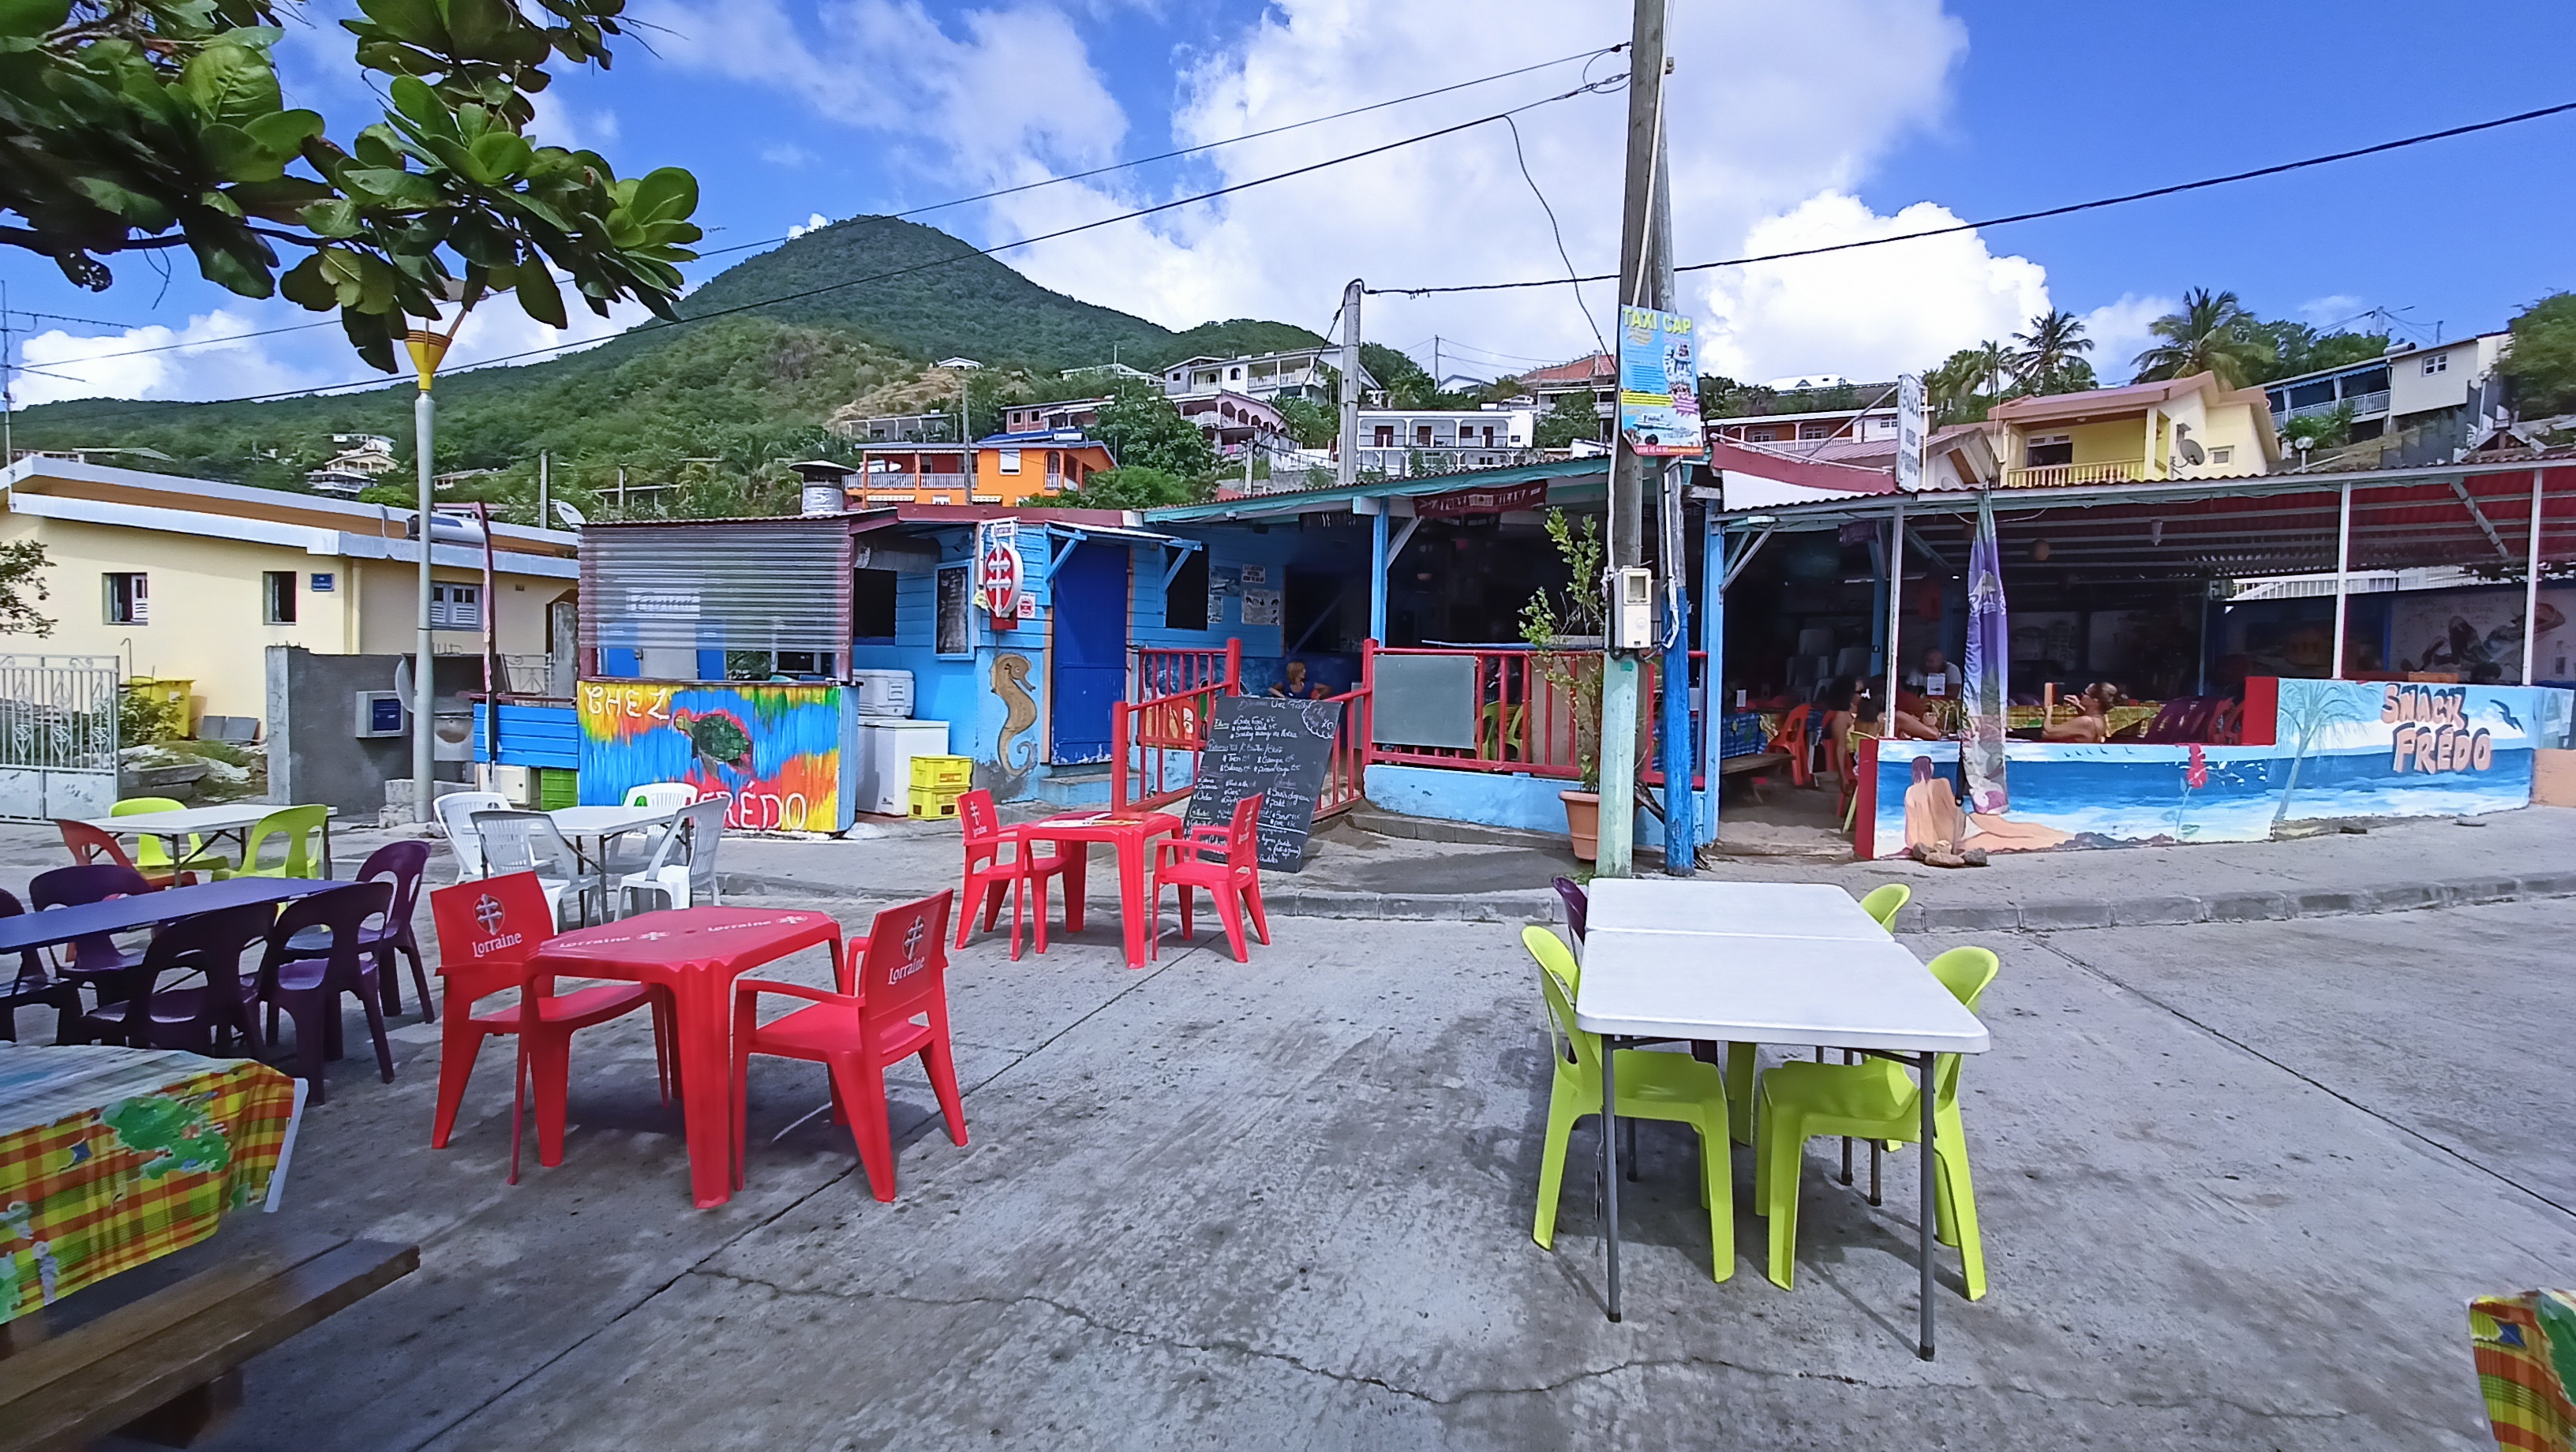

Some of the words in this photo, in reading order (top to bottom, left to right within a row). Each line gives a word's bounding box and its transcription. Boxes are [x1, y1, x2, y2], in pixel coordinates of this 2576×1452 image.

[1623, 308, 1658, 331] TAXI
[1662, 314, 1692, 335] CAP
[1493, 489, 1526, 507] MILAN
[585, 686, 670, 720] CHEZ
[2380, 683, 2468, 730] SNACK
[707, 919, 772, 933] Lorraine
[472, 933, 522, 958] Lorraine
[559, 936, 631, 949] Lorraine
[888, 956, 925, 986] Lorraine
